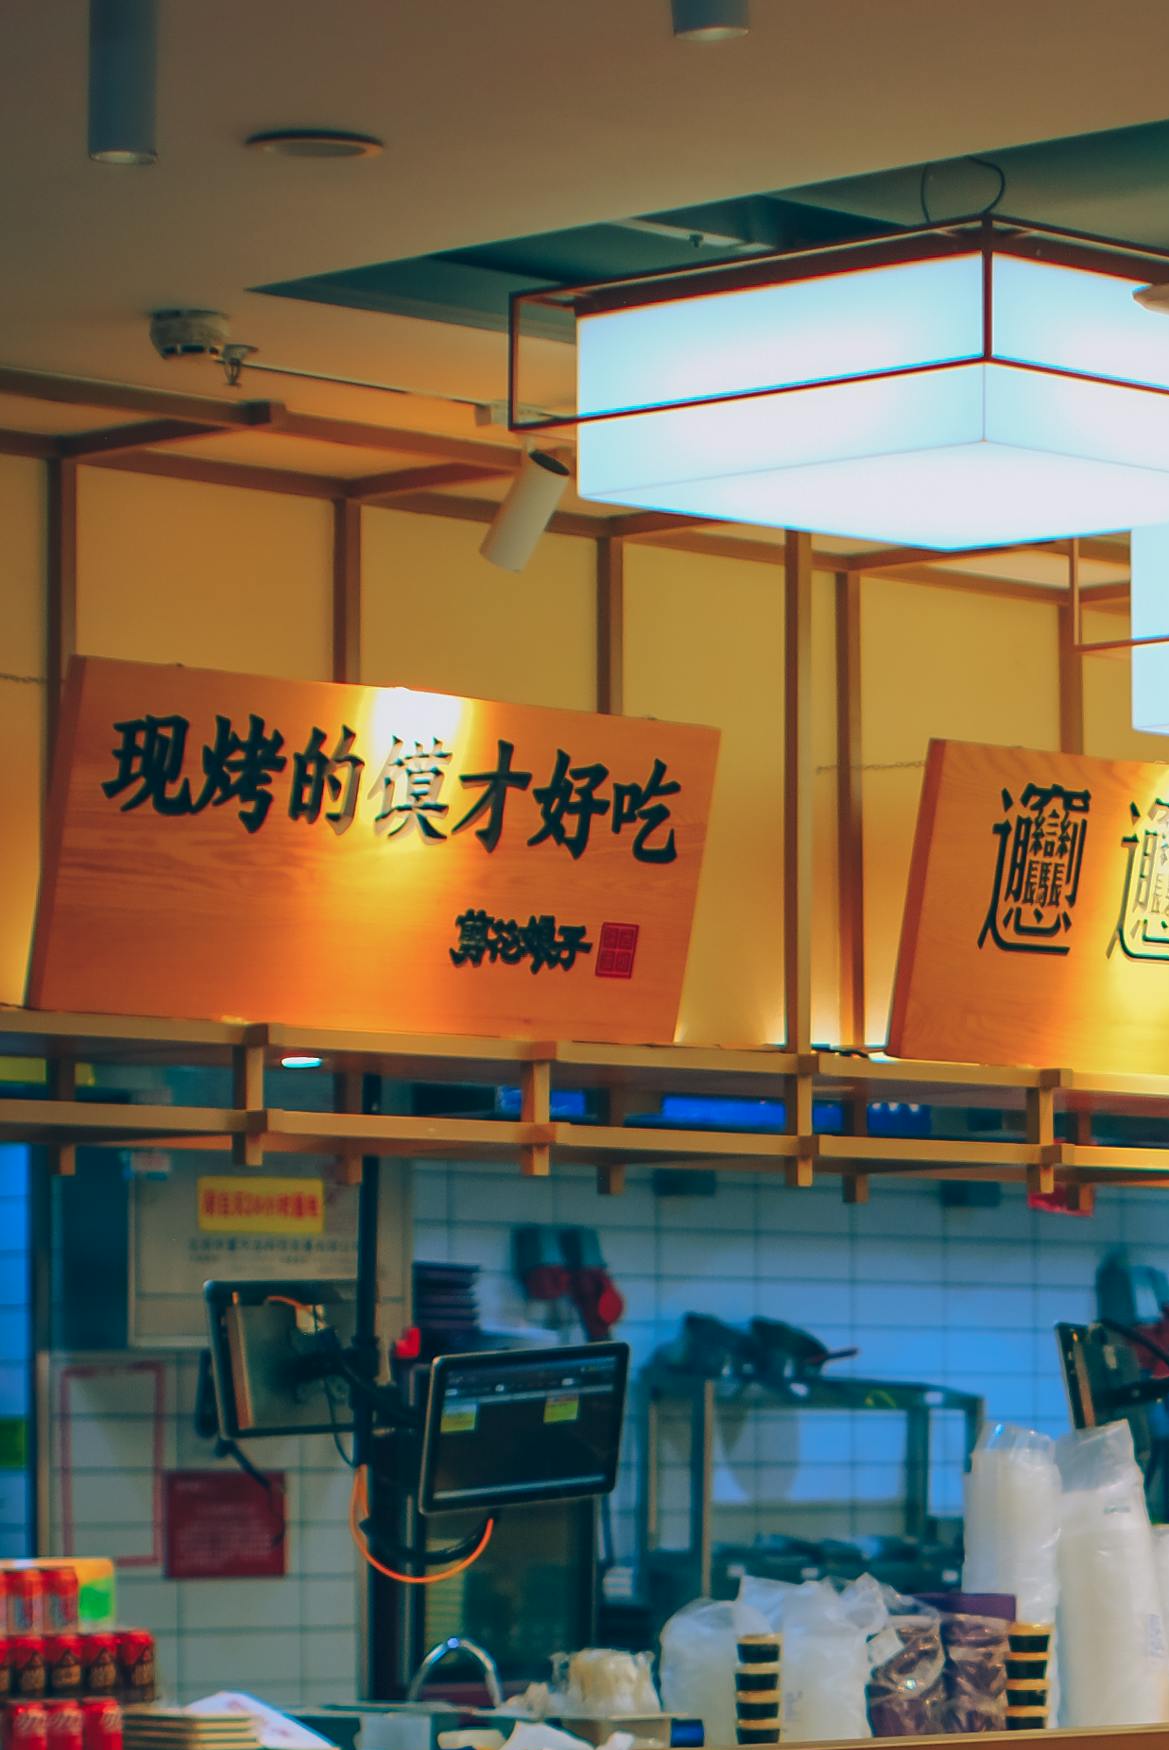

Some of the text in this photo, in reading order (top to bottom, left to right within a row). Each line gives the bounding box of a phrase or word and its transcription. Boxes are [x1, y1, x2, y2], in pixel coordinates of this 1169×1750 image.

[102, 713, 682, 865] 现烤的馍才好吃
